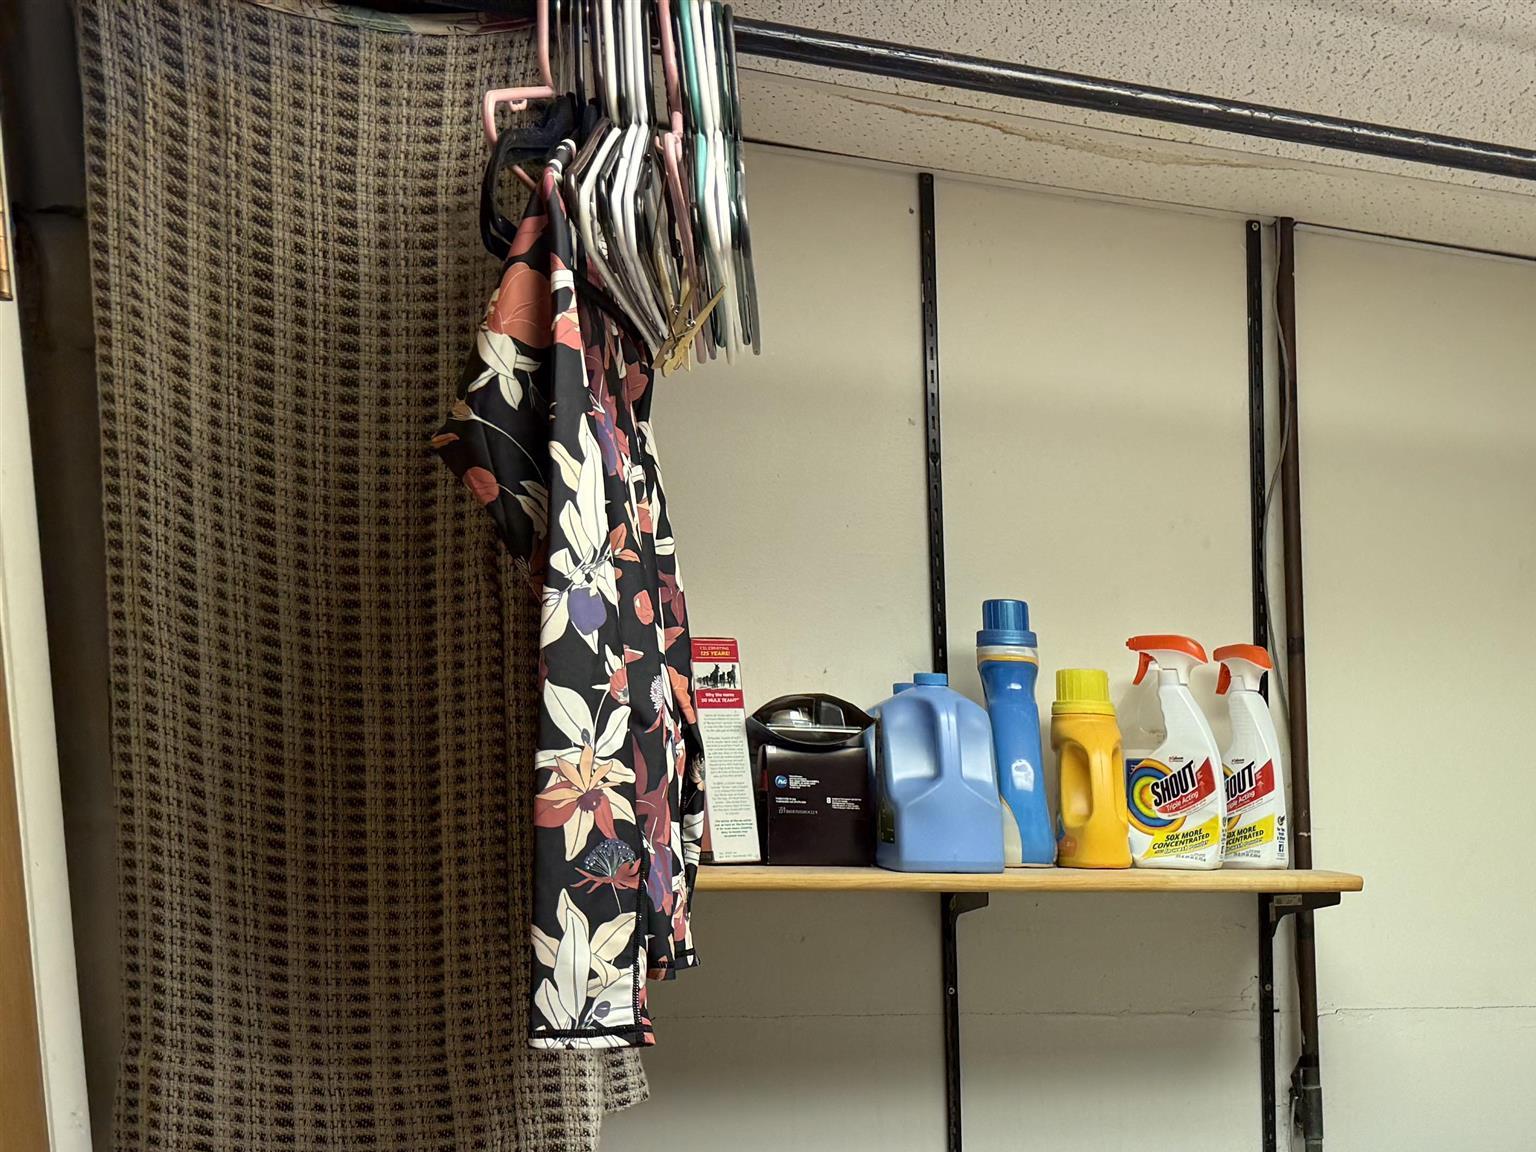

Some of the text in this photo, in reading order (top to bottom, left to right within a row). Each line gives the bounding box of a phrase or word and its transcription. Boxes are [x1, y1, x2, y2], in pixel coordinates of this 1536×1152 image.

[1150, 759, 1198, 807] SHOUT
[1165, 799, 1182, 812] Triple
[1182, 790, 1200, 805] Acting
[1238, 790, 1256, 803] Acting
[1181, 828, 1204, 839] MORE
[1236, 825, 1257, 835] MORE
[1152, 833, 1211, 850] CONCENTRATED
